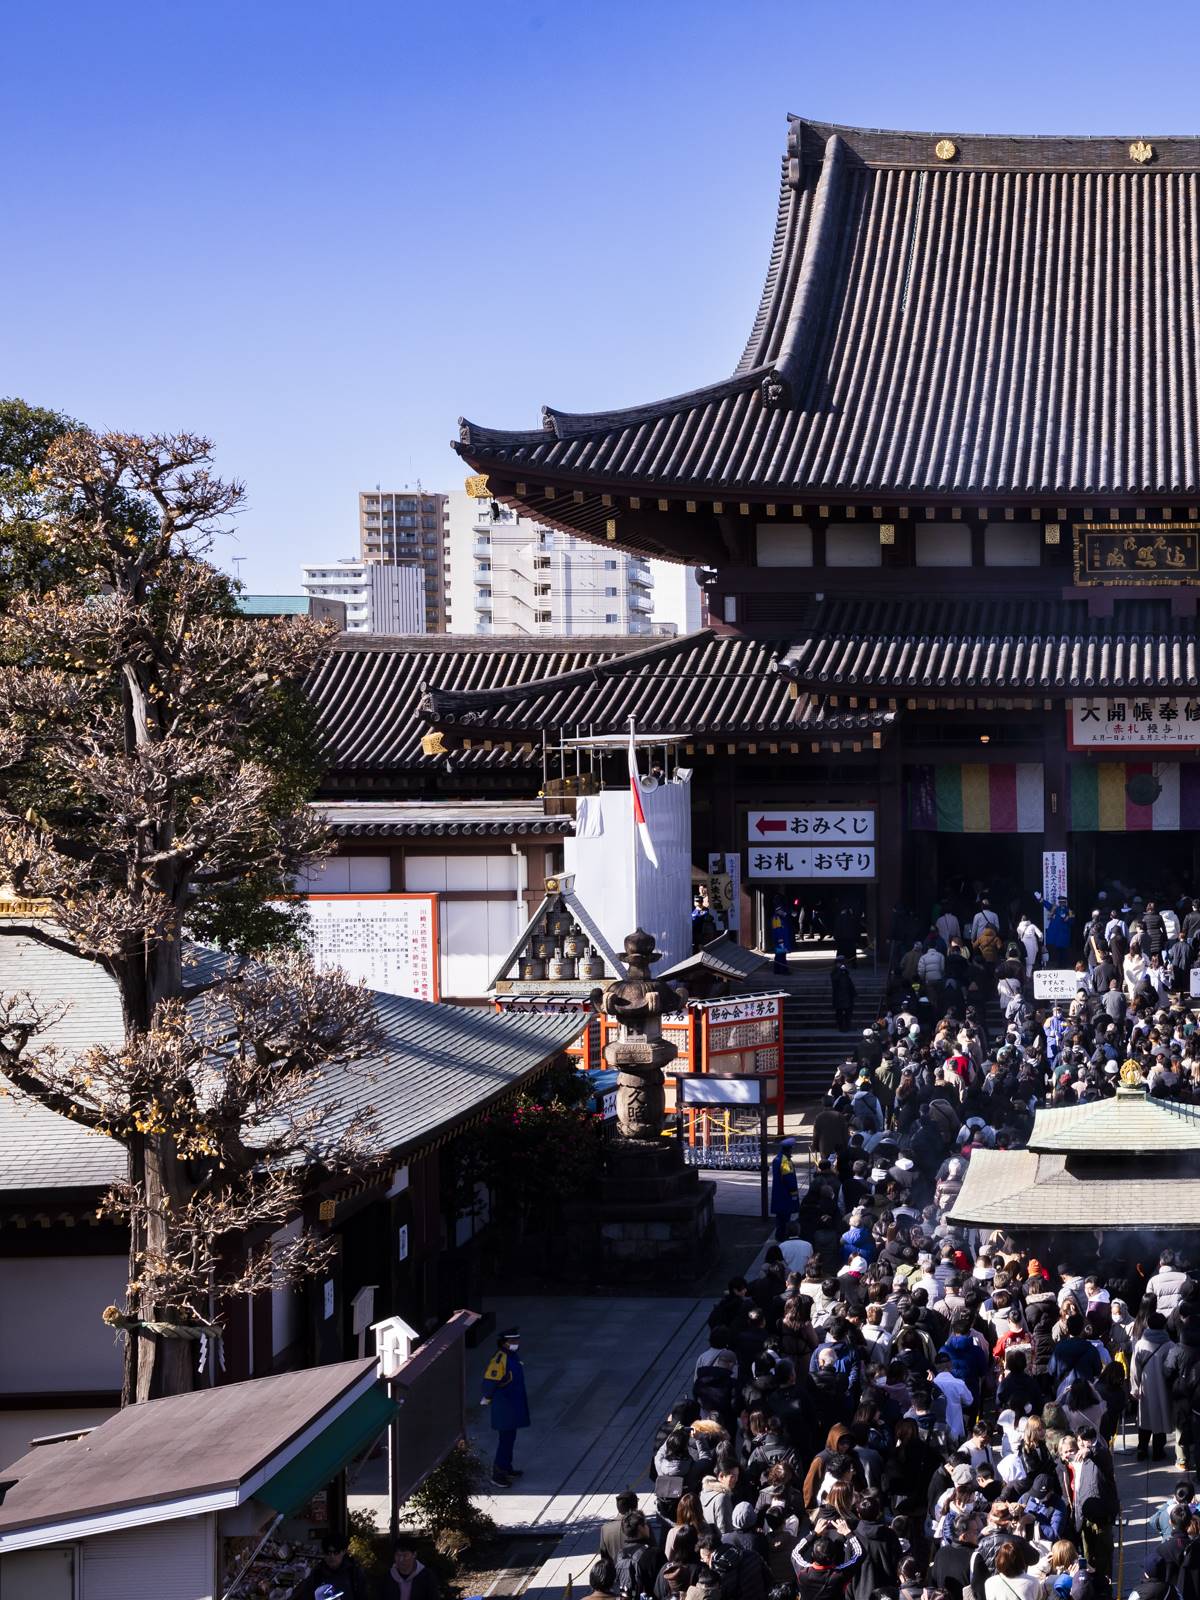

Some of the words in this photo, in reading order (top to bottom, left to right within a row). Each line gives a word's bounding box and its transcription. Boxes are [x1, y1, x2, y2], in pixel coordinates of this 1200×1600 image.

[790, 817, 868, 834] おみくじ
[754, 852, 870, 871] お札・お守り
[710, 1005, 744, 1021] 節分会
